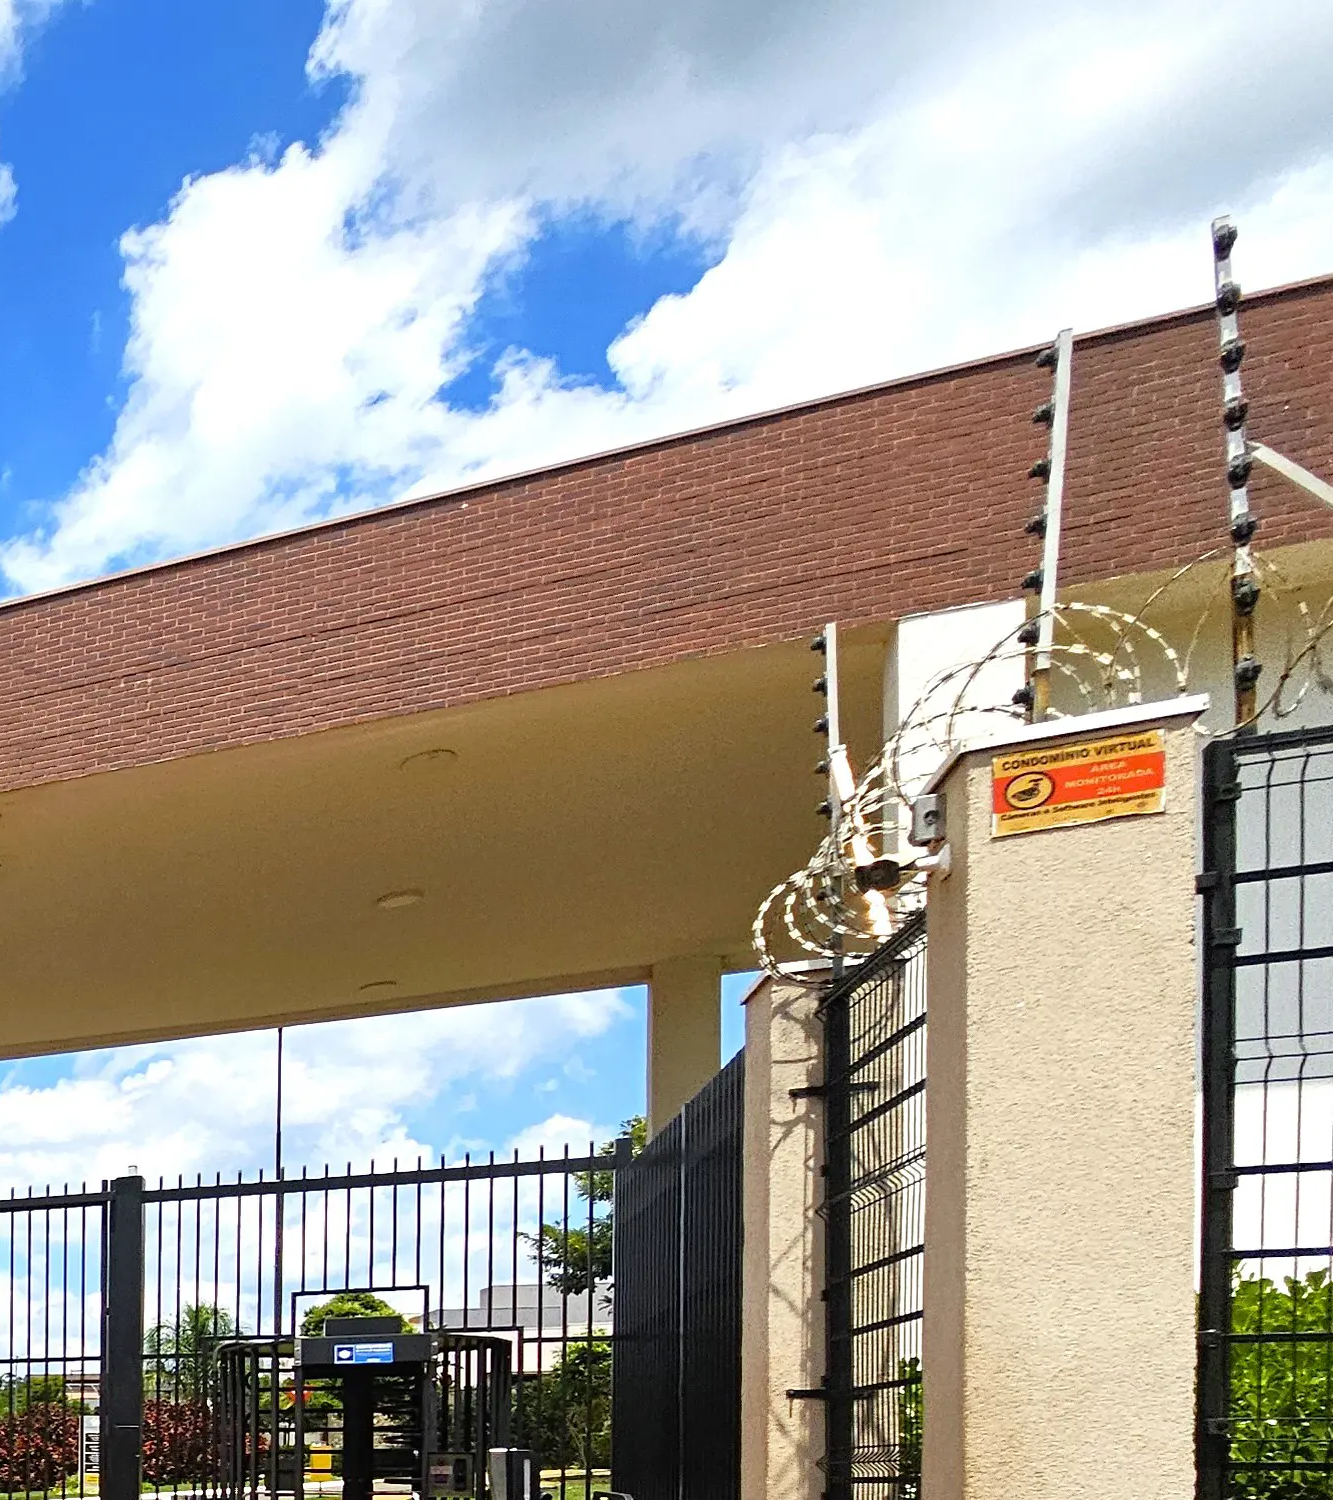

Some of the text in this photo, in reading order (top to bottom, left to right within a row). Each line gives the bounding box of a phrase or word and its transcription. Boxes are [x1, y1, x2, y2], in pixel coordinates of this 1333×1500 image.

[1002, 737, 1155, 771] CONDOMÍNIO VIRTUAL
[1065, 767, 1156, 789] MONITORADA
